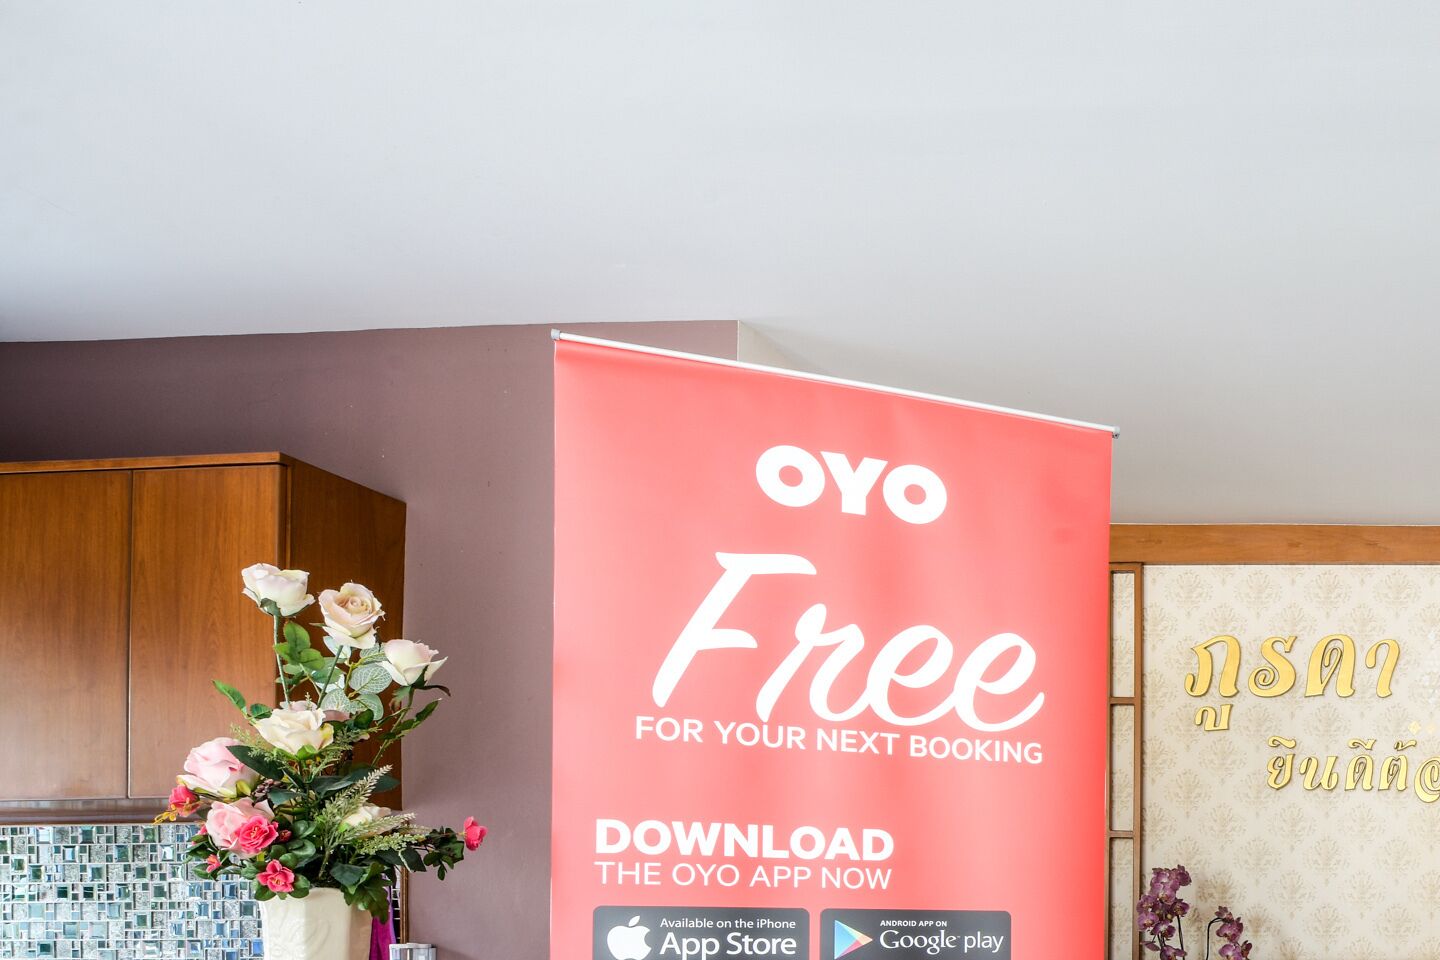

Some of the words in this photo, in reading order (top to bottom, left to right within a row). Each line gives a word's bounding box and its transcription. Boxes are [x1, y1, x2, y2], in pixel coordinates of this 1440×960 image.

[755, 444, 948, 525] OYO
[652, 552, 1045, 732] Free
[1184, 633, 1401, 731] ภูรดา
[636, 715, 704, 743] FOR
[713, 721, 807, 751] YOUR
[817, 727, 900, 757] NEXT
[909, 735, 1044, 765] BOOKING
[595, 819, 895, 861] DOWNLOAD
[595, 861, 662, 887] THE
[672, 862, 741, 888] OYO
[749, 865, 811, 888] APP
[821, 867, 893, 890] NOW
[660, 918, 713, 928] Available
[716, 920, 732, 928] on
[735, 918, 753, 928] the
[757, 919, 796, 929] iPhone
[880, 930, 958, 955] Google
[964, 931, 1004, 953] play
[660, 932, 720, 960] App
[726, 932, 797, 955] Store
